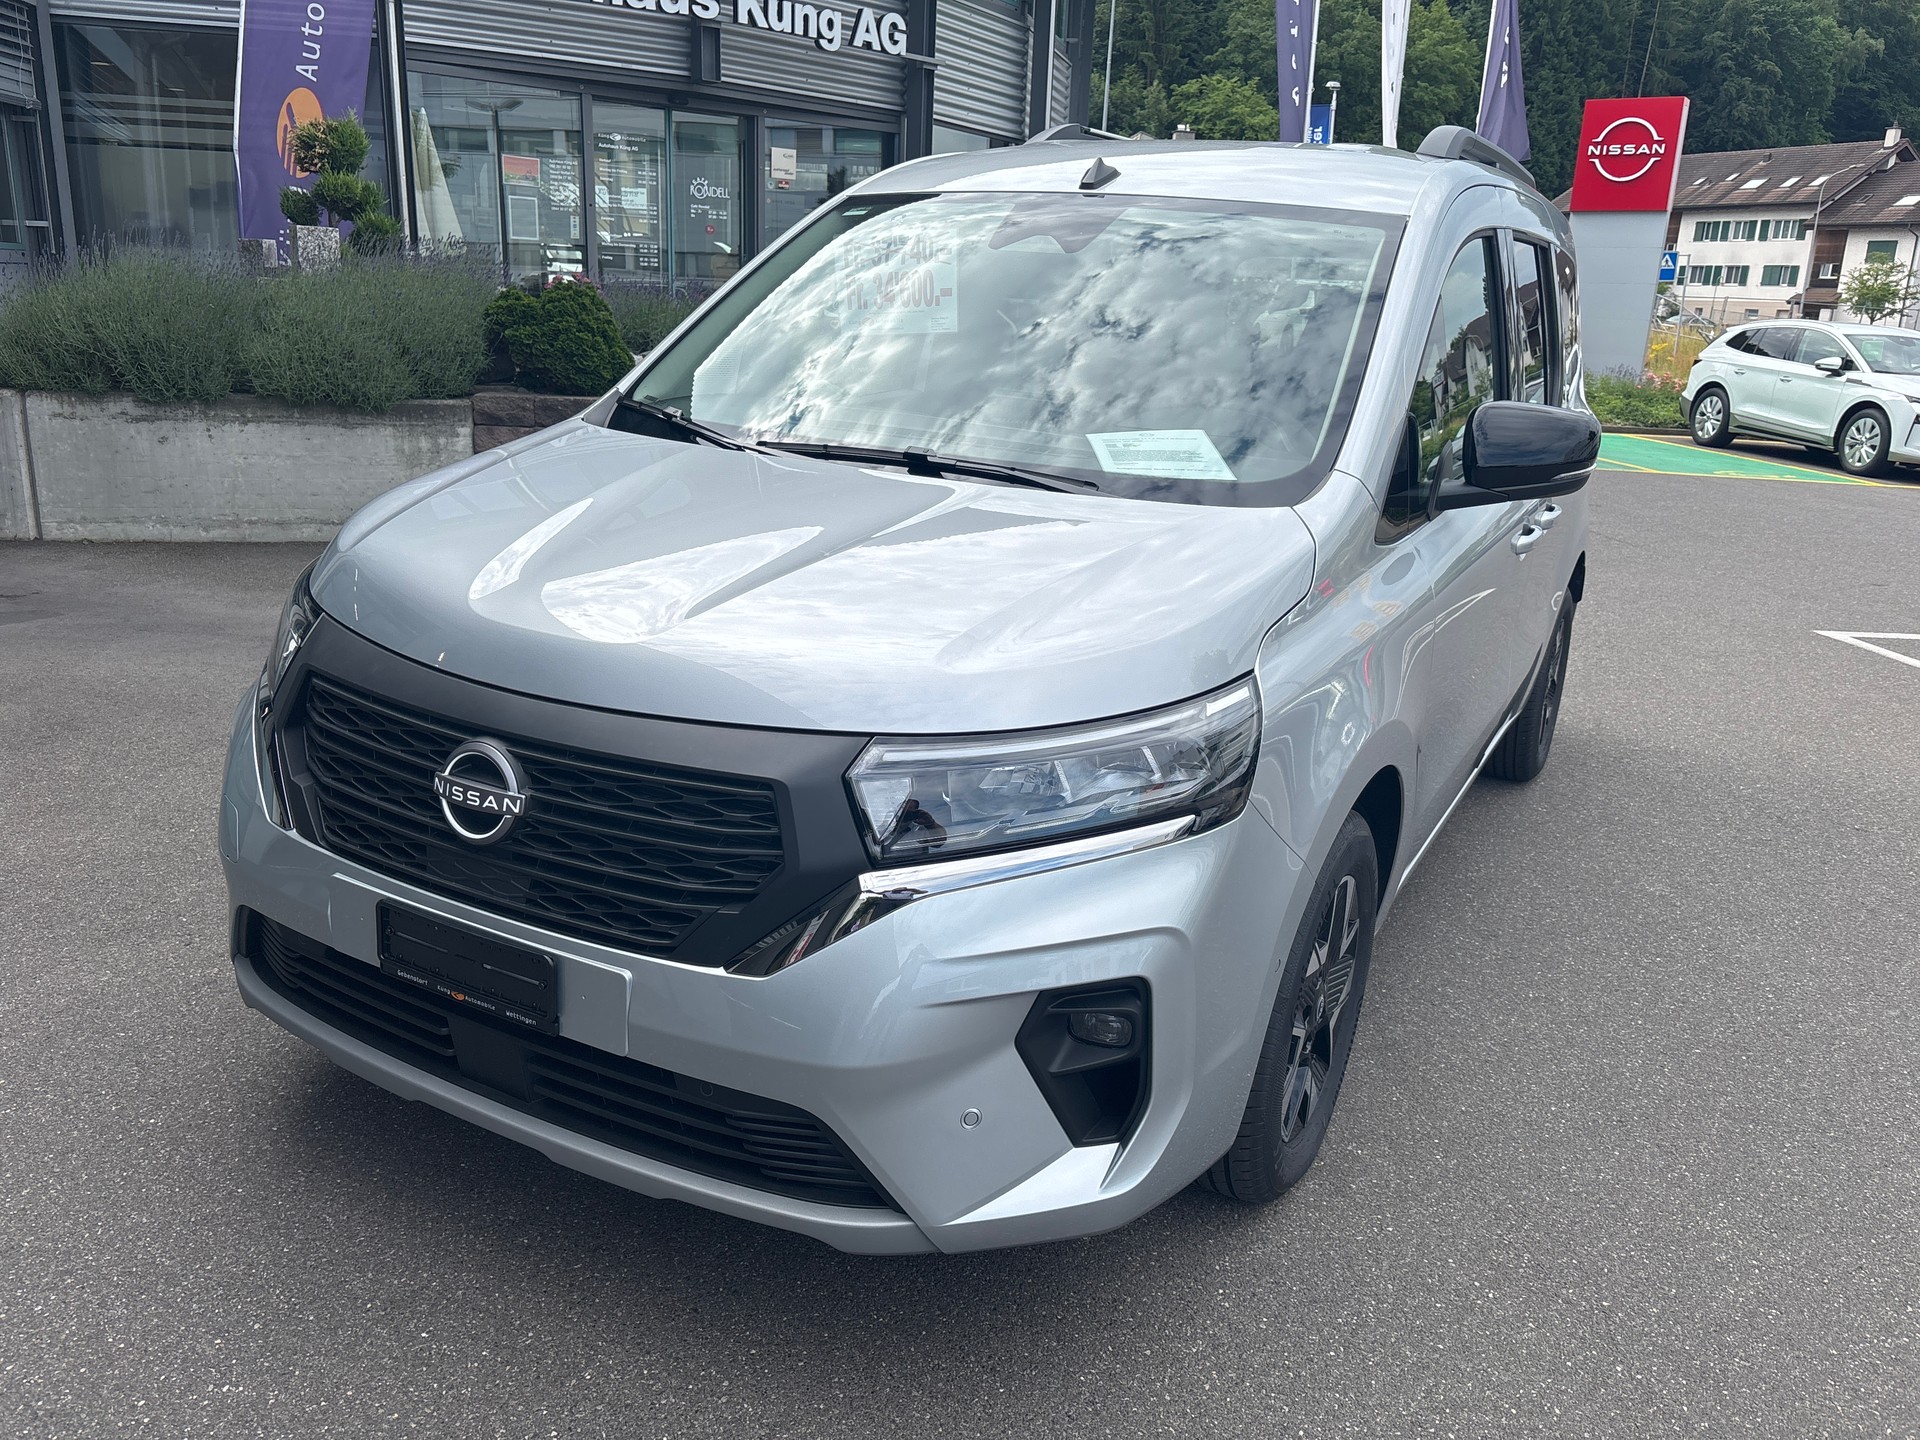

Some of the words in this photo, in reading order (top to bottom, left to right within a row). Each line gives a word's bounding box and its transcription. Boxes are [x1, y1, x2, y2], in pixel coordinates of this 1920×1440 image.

[295, 2, 325, 83] Auto
[853, 7, 907, 56] AG
[1587, 143, 1666, 156] NISSAN
[433, 776, 521, 813] NISSAN
[505, 1009, 537, 1026] Wettingen
